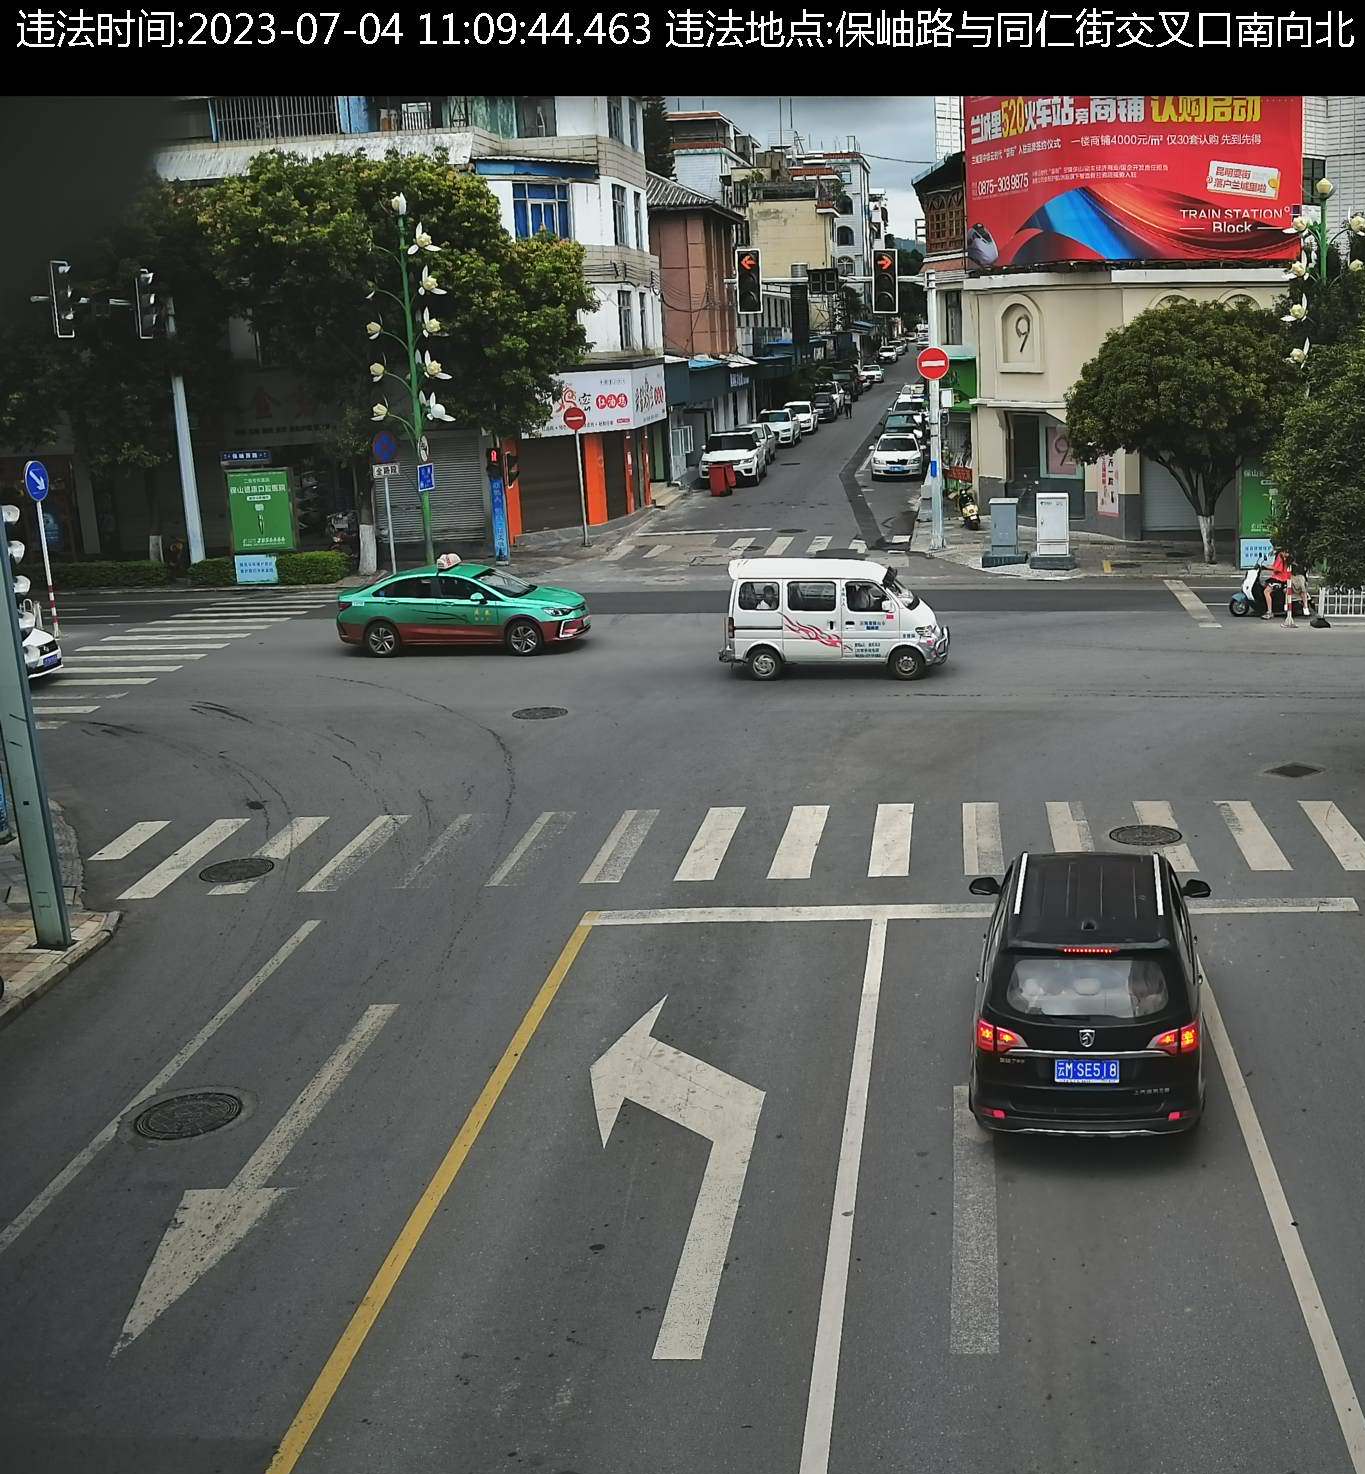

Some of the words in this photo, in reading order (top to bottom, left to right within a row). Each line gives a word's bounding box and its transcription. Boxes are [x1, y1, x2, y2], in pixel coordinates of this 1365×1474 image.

[1221, 133, 1262, 146] 先到先得
[1180, 209, 1221, 219] TRAIN
[1224, 209, 1283, 219] STATION
[1212, 221, 1252, 233] Block
